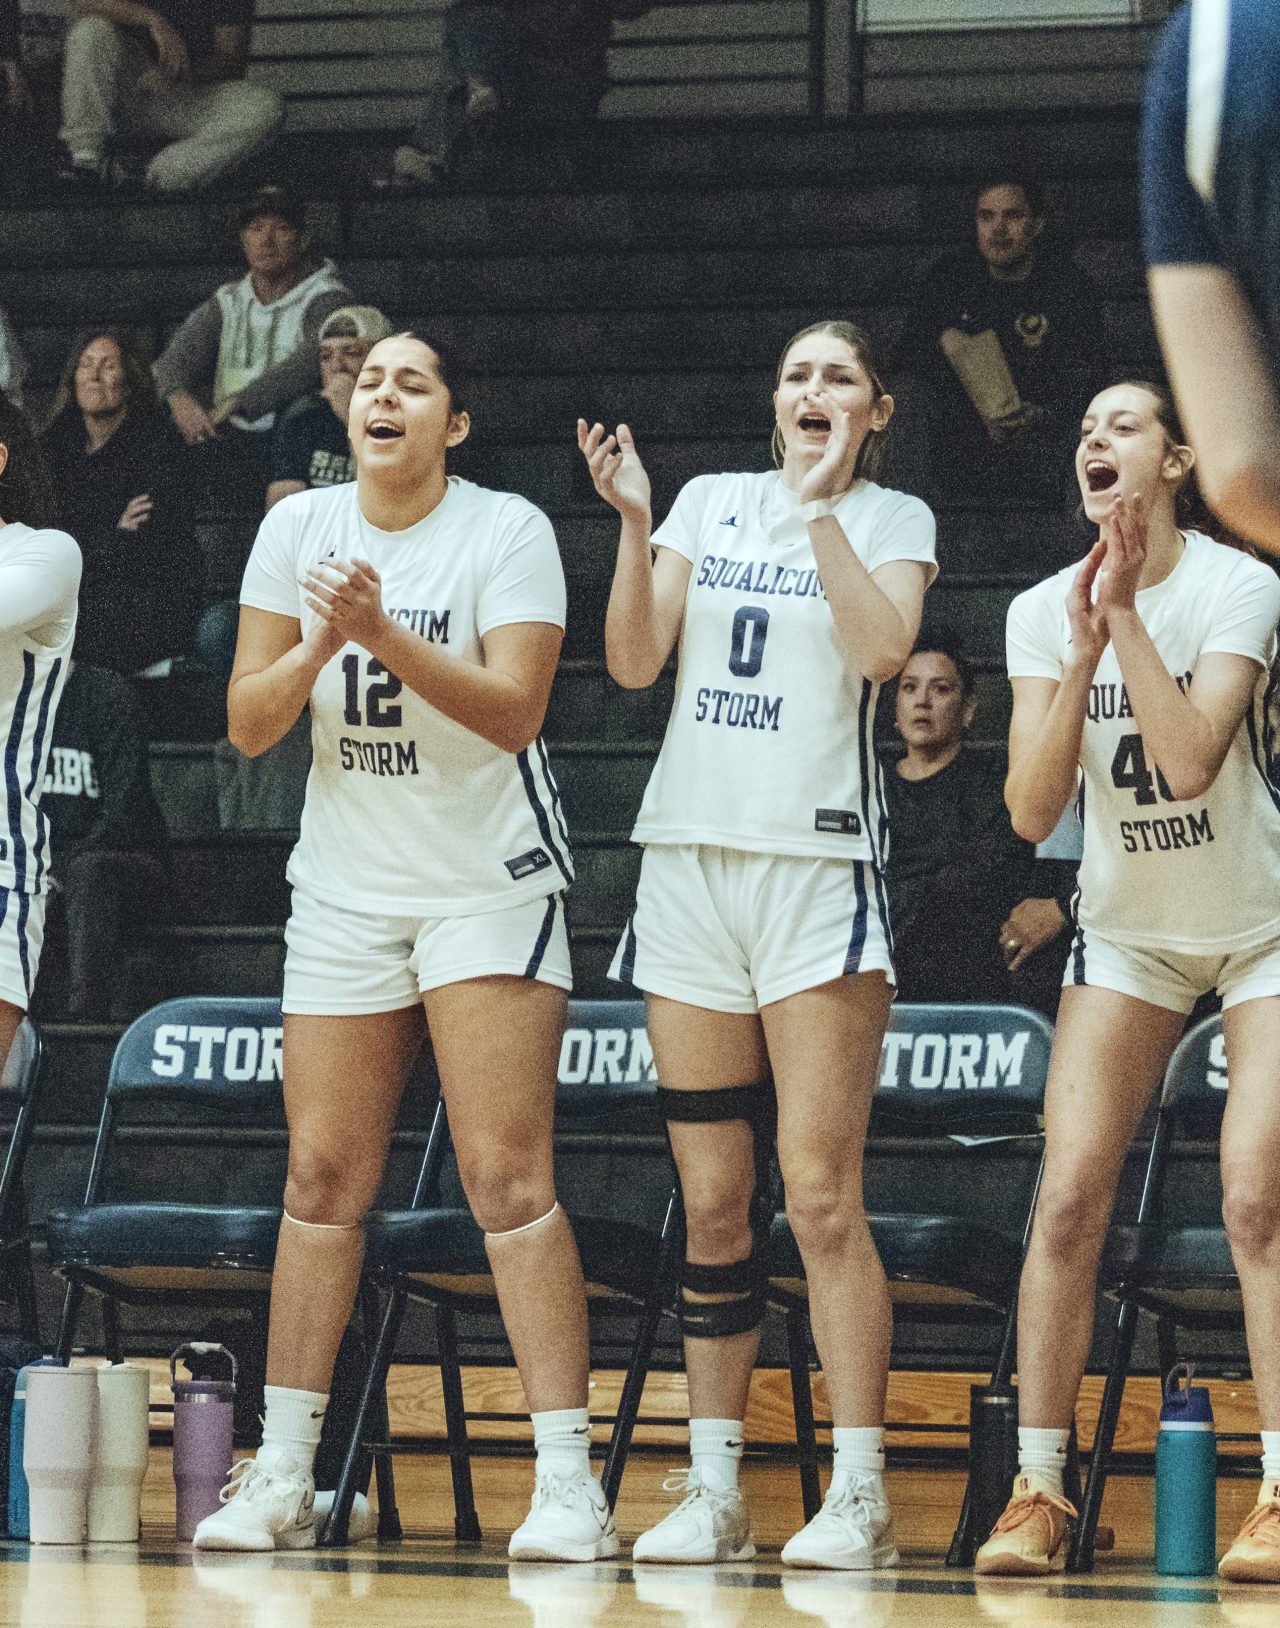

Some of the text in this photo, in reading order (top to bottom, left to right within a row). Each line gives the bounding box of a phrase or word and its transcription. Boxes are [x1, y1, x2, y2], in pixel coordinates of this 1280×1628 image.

[728, 606, 770, 678] 0
[342, 654, 402, 727] 12
[696, 687, 783, 731] STORM
[340, 737, 419, 776] STORM
[1111, 733, 1176, 806] 4
[1121, 808, 1215, 853] STORM
[532, 853, 547, 864] XL
